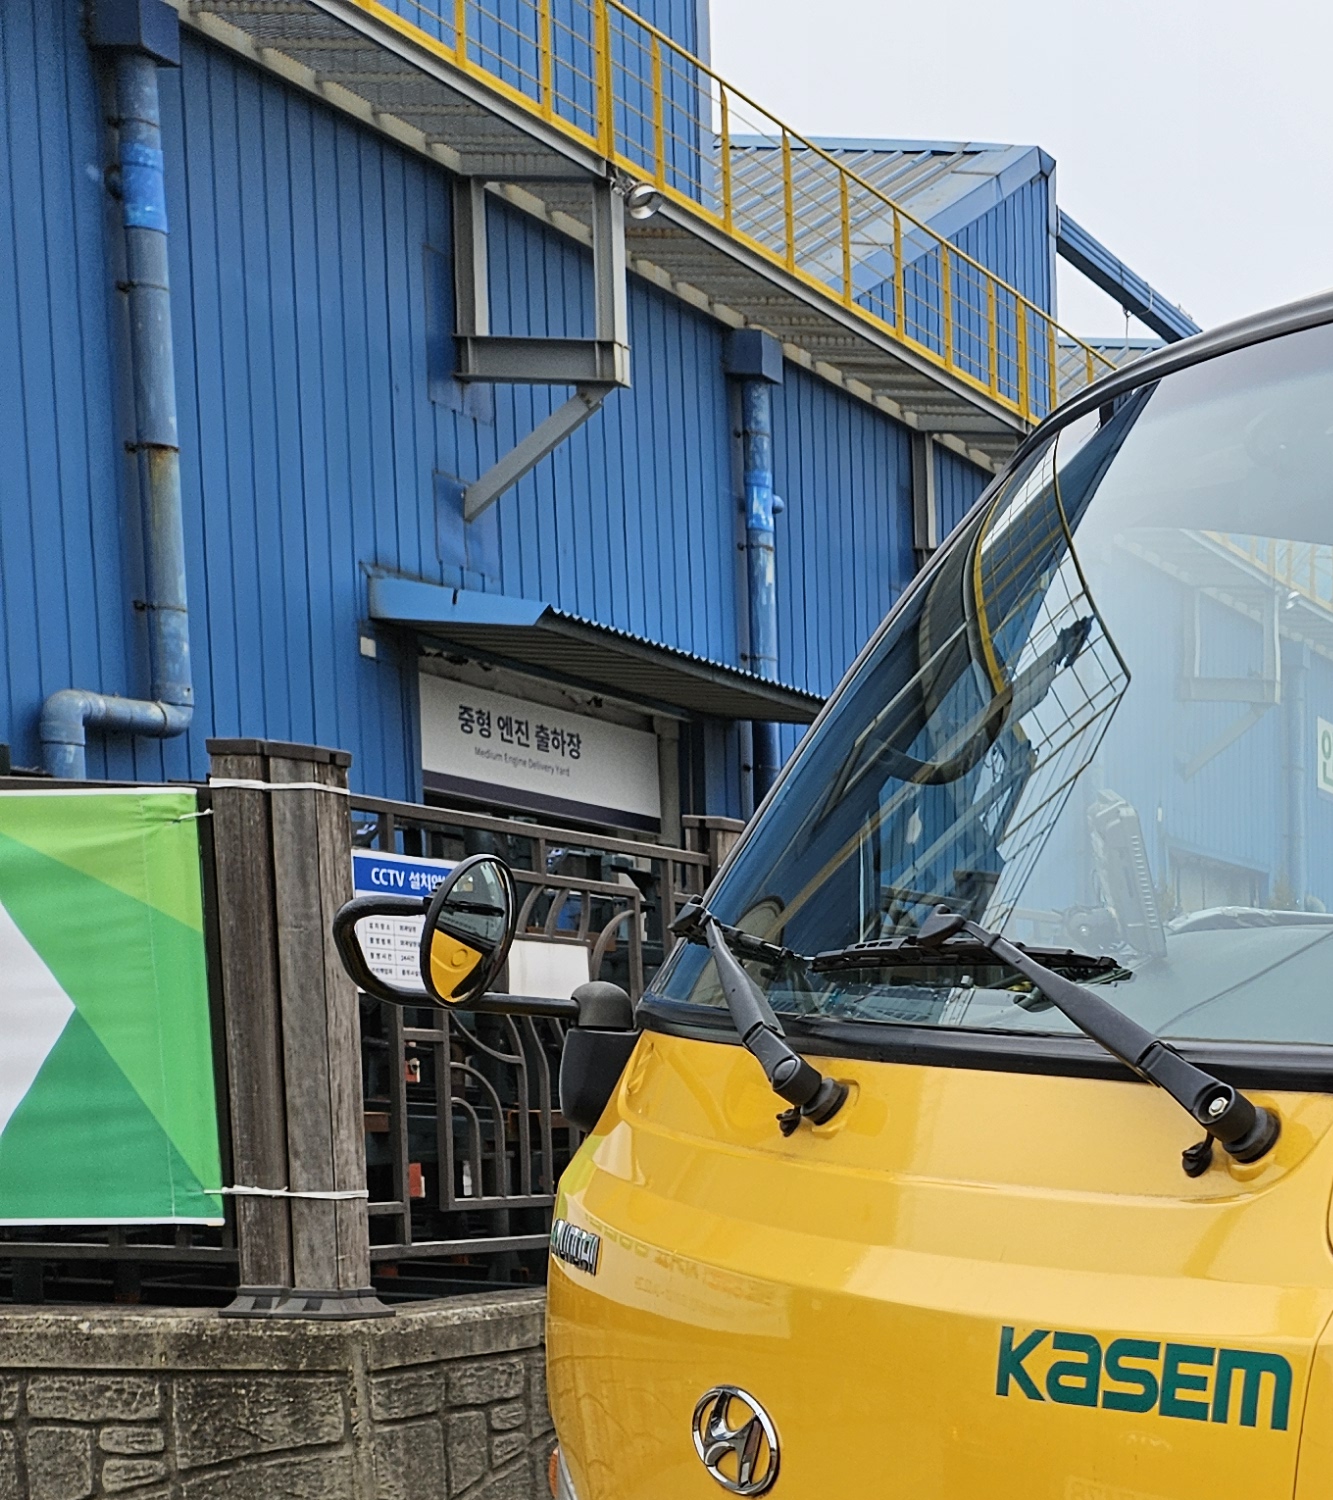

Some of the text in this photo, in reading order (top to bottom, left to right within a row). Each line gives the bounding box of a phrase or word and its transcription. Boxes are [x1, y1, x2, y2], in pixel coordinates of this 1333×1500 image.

[458, 704, 582, 760] 중형 엔진 출하장
[474, 746, 571, 777] Medium Engine Delivery Yard
[371, 867, 405, 888] CCTV
